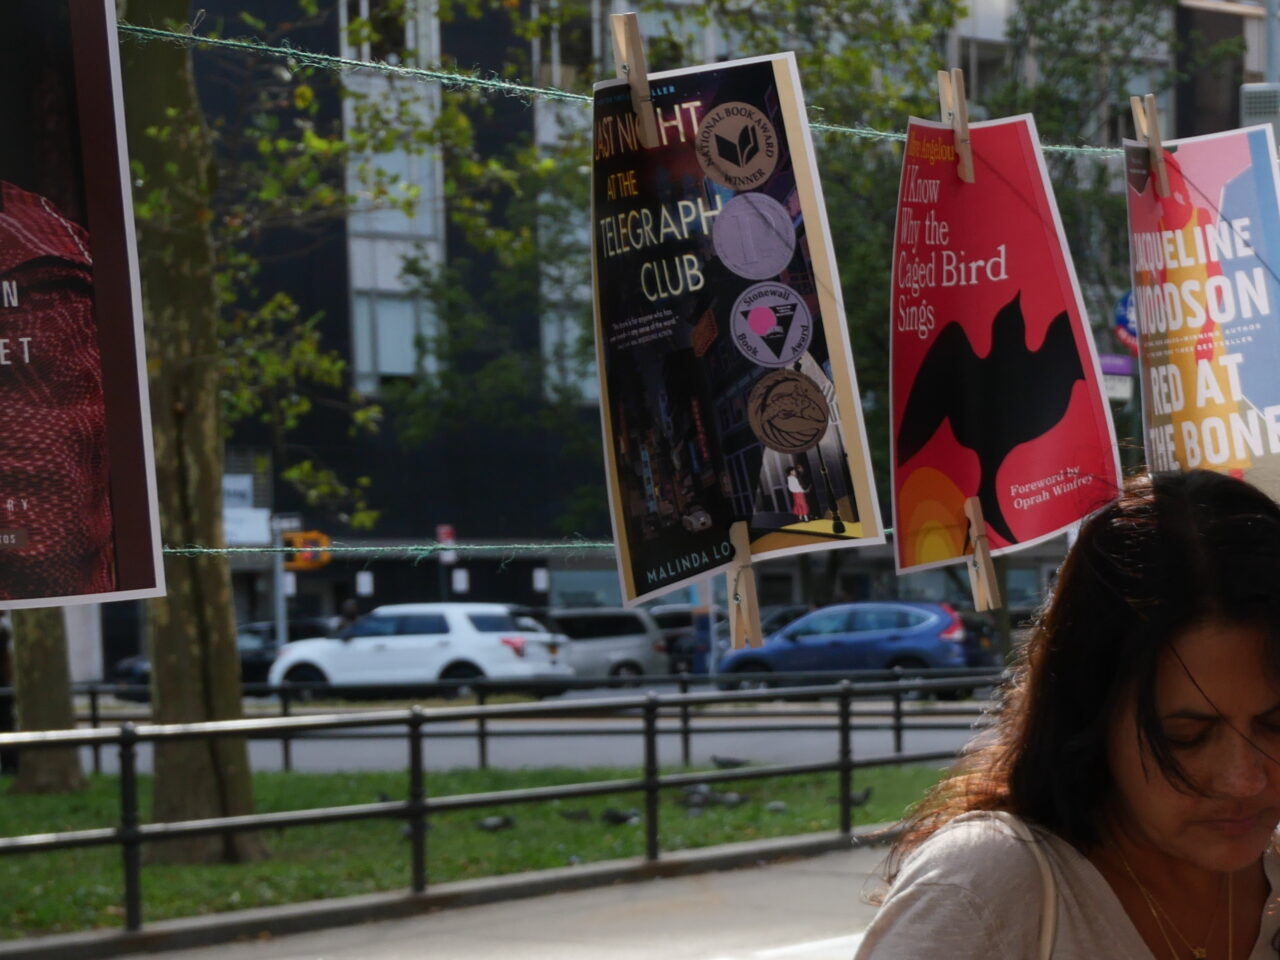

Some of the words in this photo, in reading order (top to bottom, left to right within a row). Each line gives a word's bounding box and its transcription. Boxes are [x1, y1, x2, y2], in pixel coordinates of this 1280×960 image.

[616, 100, 703, 153] NIHT
[702, 113, 725, 168] NATIONAL
[724, 106, 755, 120] BOOK
[755, 118, 775, 159] AWARD
[616, 170, 640, 198] THE
[723, 168, 766, 187] WINNER
[908, 165, 940, 203] Know
[600, 194, 723, 258] TELEGRAPH
[901, 207, 921, 254] Why
[925, 209, 949, 246] the
[641, 254, 705, 301] CLUB
[898, 251, 936, 298] Caged
[941, 244, 1009, 287] Bird
[743, 289, 791, 307] Stonewall
[897, 294, 936, 340] Sings
[1136, 267, 1271, 336] WOODSON
[737, 333, 760, 357] Book
[791, 324, 809, 355] Award
[1150, 363, 1186, 416] RED
[1196, 352, 1244, 408] AT
[1150, 423, 1180, 473] THE
[1010, 469, 1065, 496] Foreword
[1066, 465, 1080, 479] by
[1014, 490, 1050, 510] Oprah
[1052, 473, 1094, 496] Winfrey
[646, 552, 709, 584] MALINDA
[714, 541, 730, 560] LO
